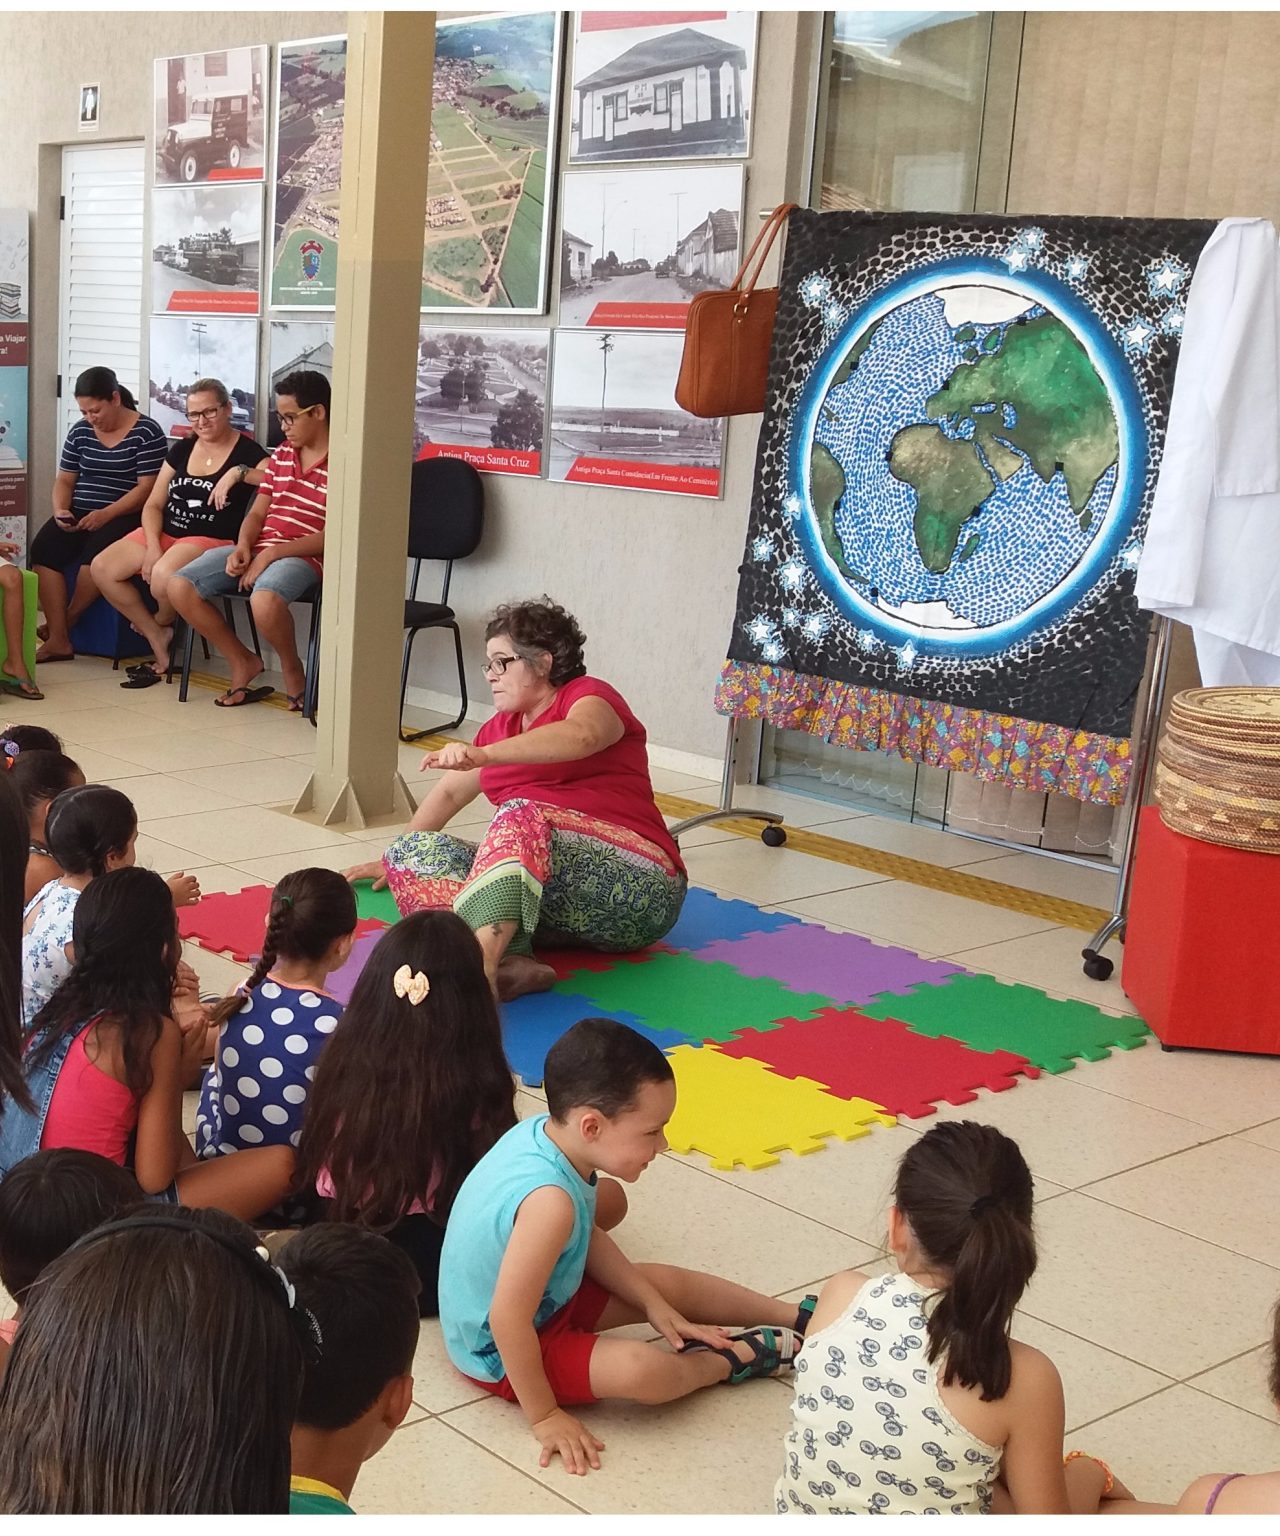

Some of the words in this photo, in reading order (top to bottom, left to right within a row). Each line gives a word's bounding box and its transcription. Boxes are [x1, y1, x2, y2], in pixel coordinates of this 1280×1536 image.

[5, 334, 27, 345] Viajar
[464, 451, 485, 464] Praça
[487, 454, 509, 466] Santa
[510, 455, 530, 468] Cruz
[575, 465, 591, 474] Antiga
[591, 466, 606, 476] Praça
[607, 468, 621, 477] Santa
[661, 472, 679, 482] Frente
[679, 475, 688, 483] Ao
[168, 478, 214, 492] ALIFOR
